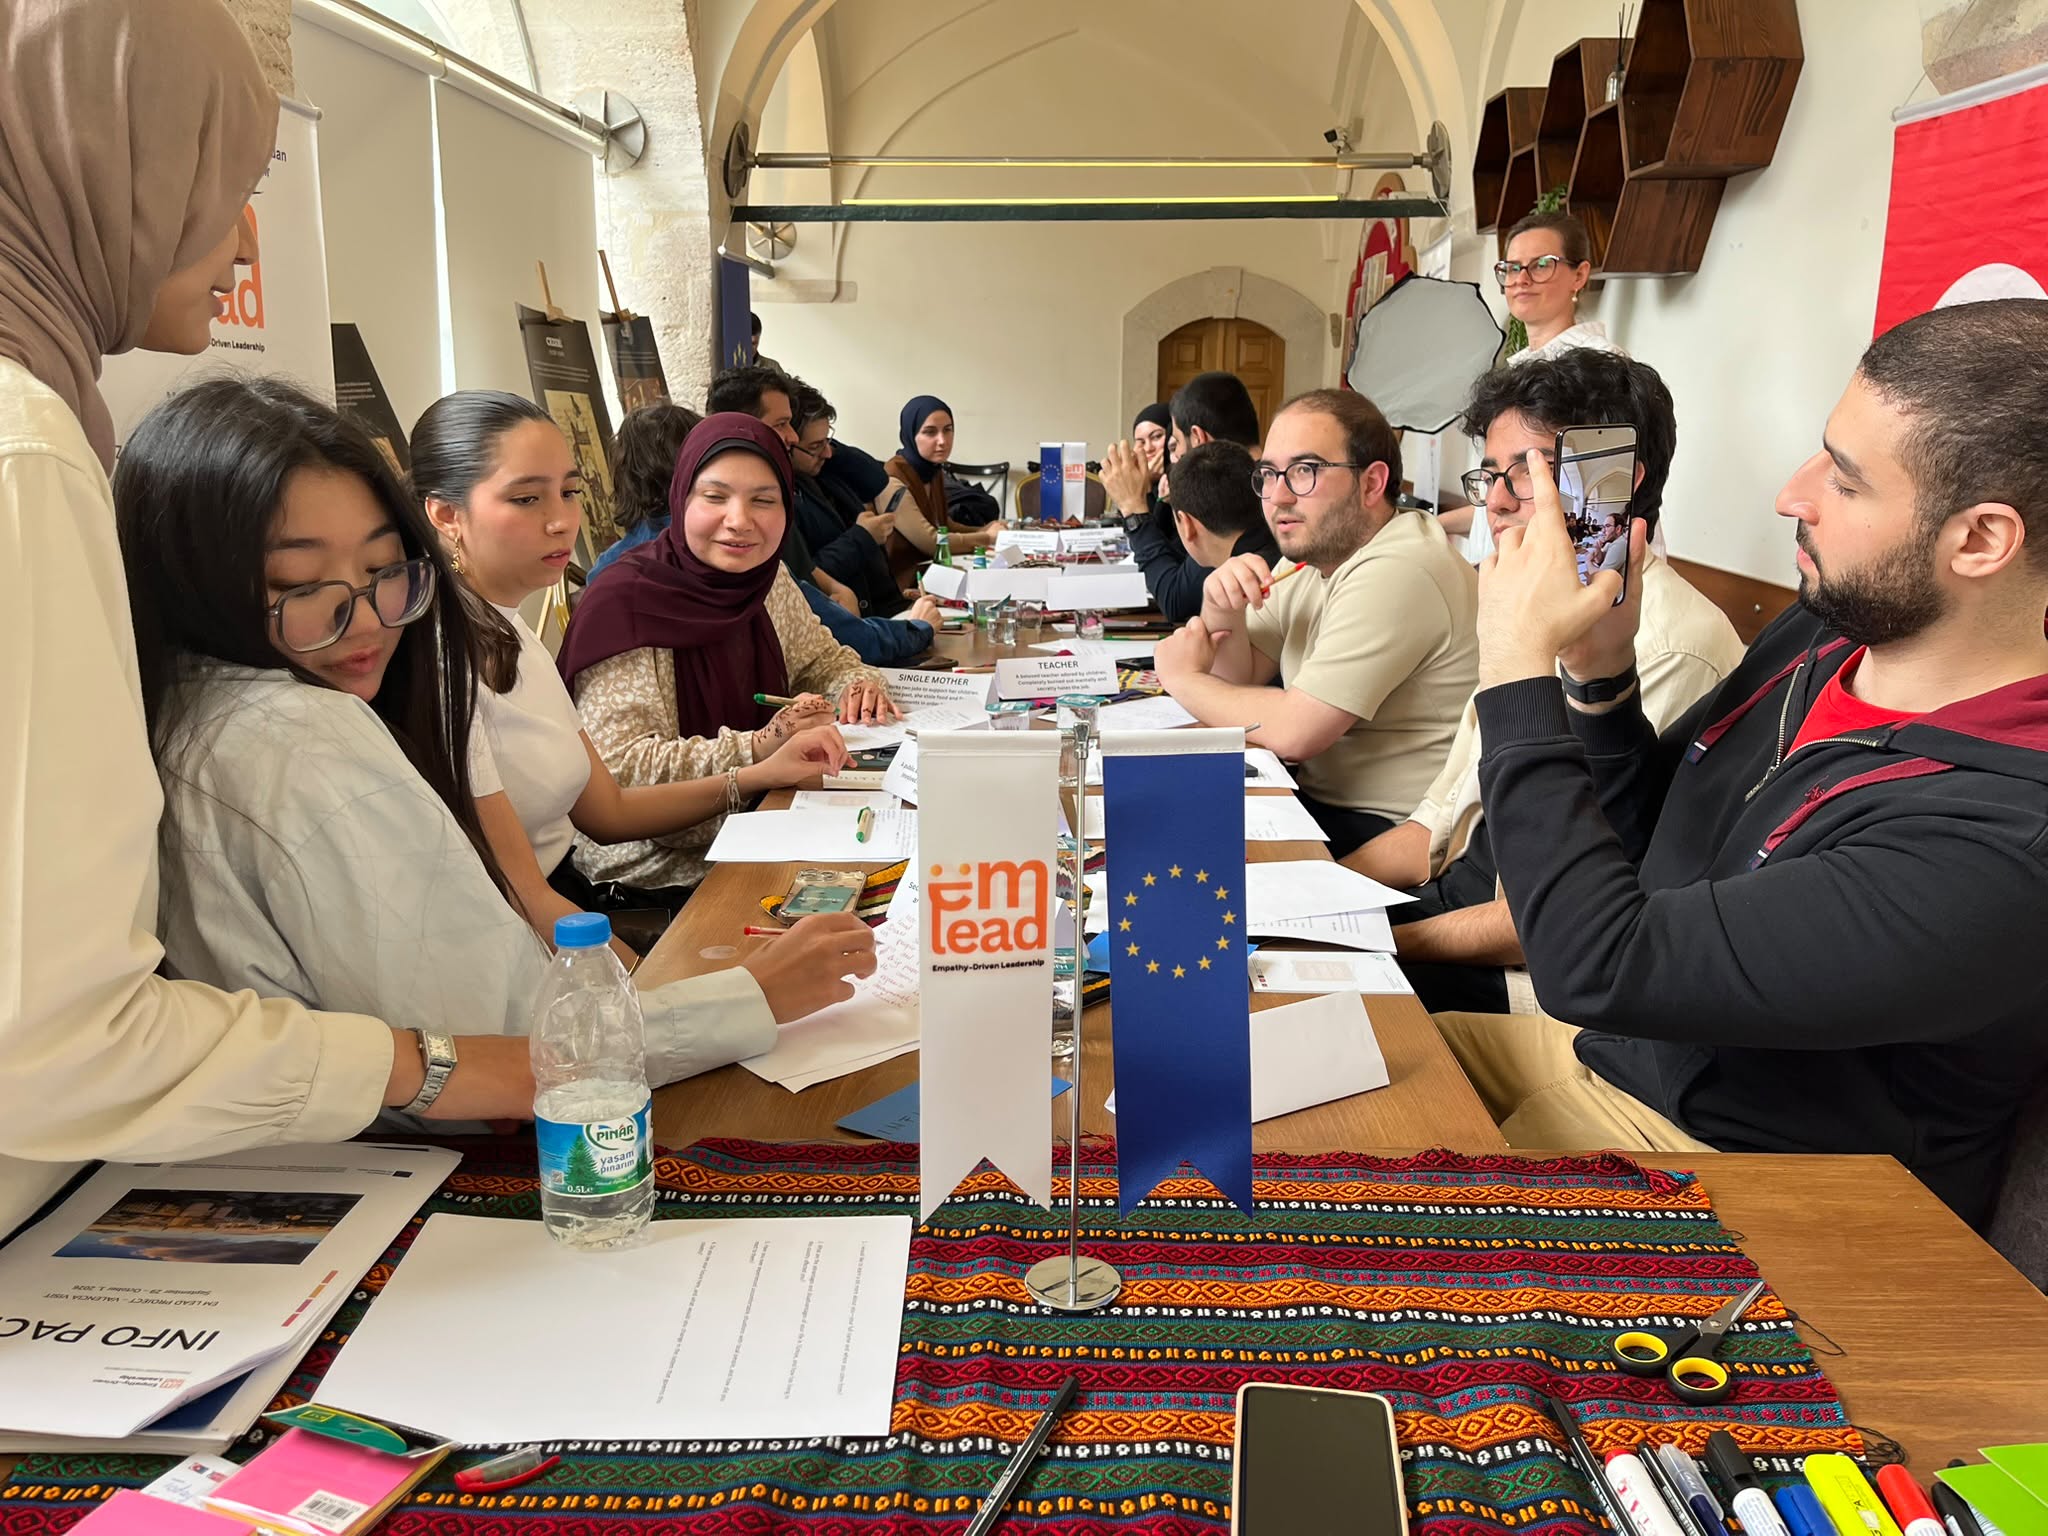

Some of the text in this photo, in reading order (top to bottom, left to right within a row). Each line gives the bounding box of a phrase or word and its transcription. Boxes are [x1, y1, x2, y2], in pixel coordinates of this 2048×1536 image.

[231, 340, 266, 354] Leadership
[1037, 660, 1079, 670] TEACHER
[898, 673, 969, 686] SINGLE MOTHER
[932, 962, 1000, 973] Empathy-Driven
[1000, 958, 1045, 970] Leadership
[72, 1295, 120, 1303] VALENCIA
[128, 1297, 173, 1305] PROJECT
[0, 1317, 220, 1351] INFO PAC
